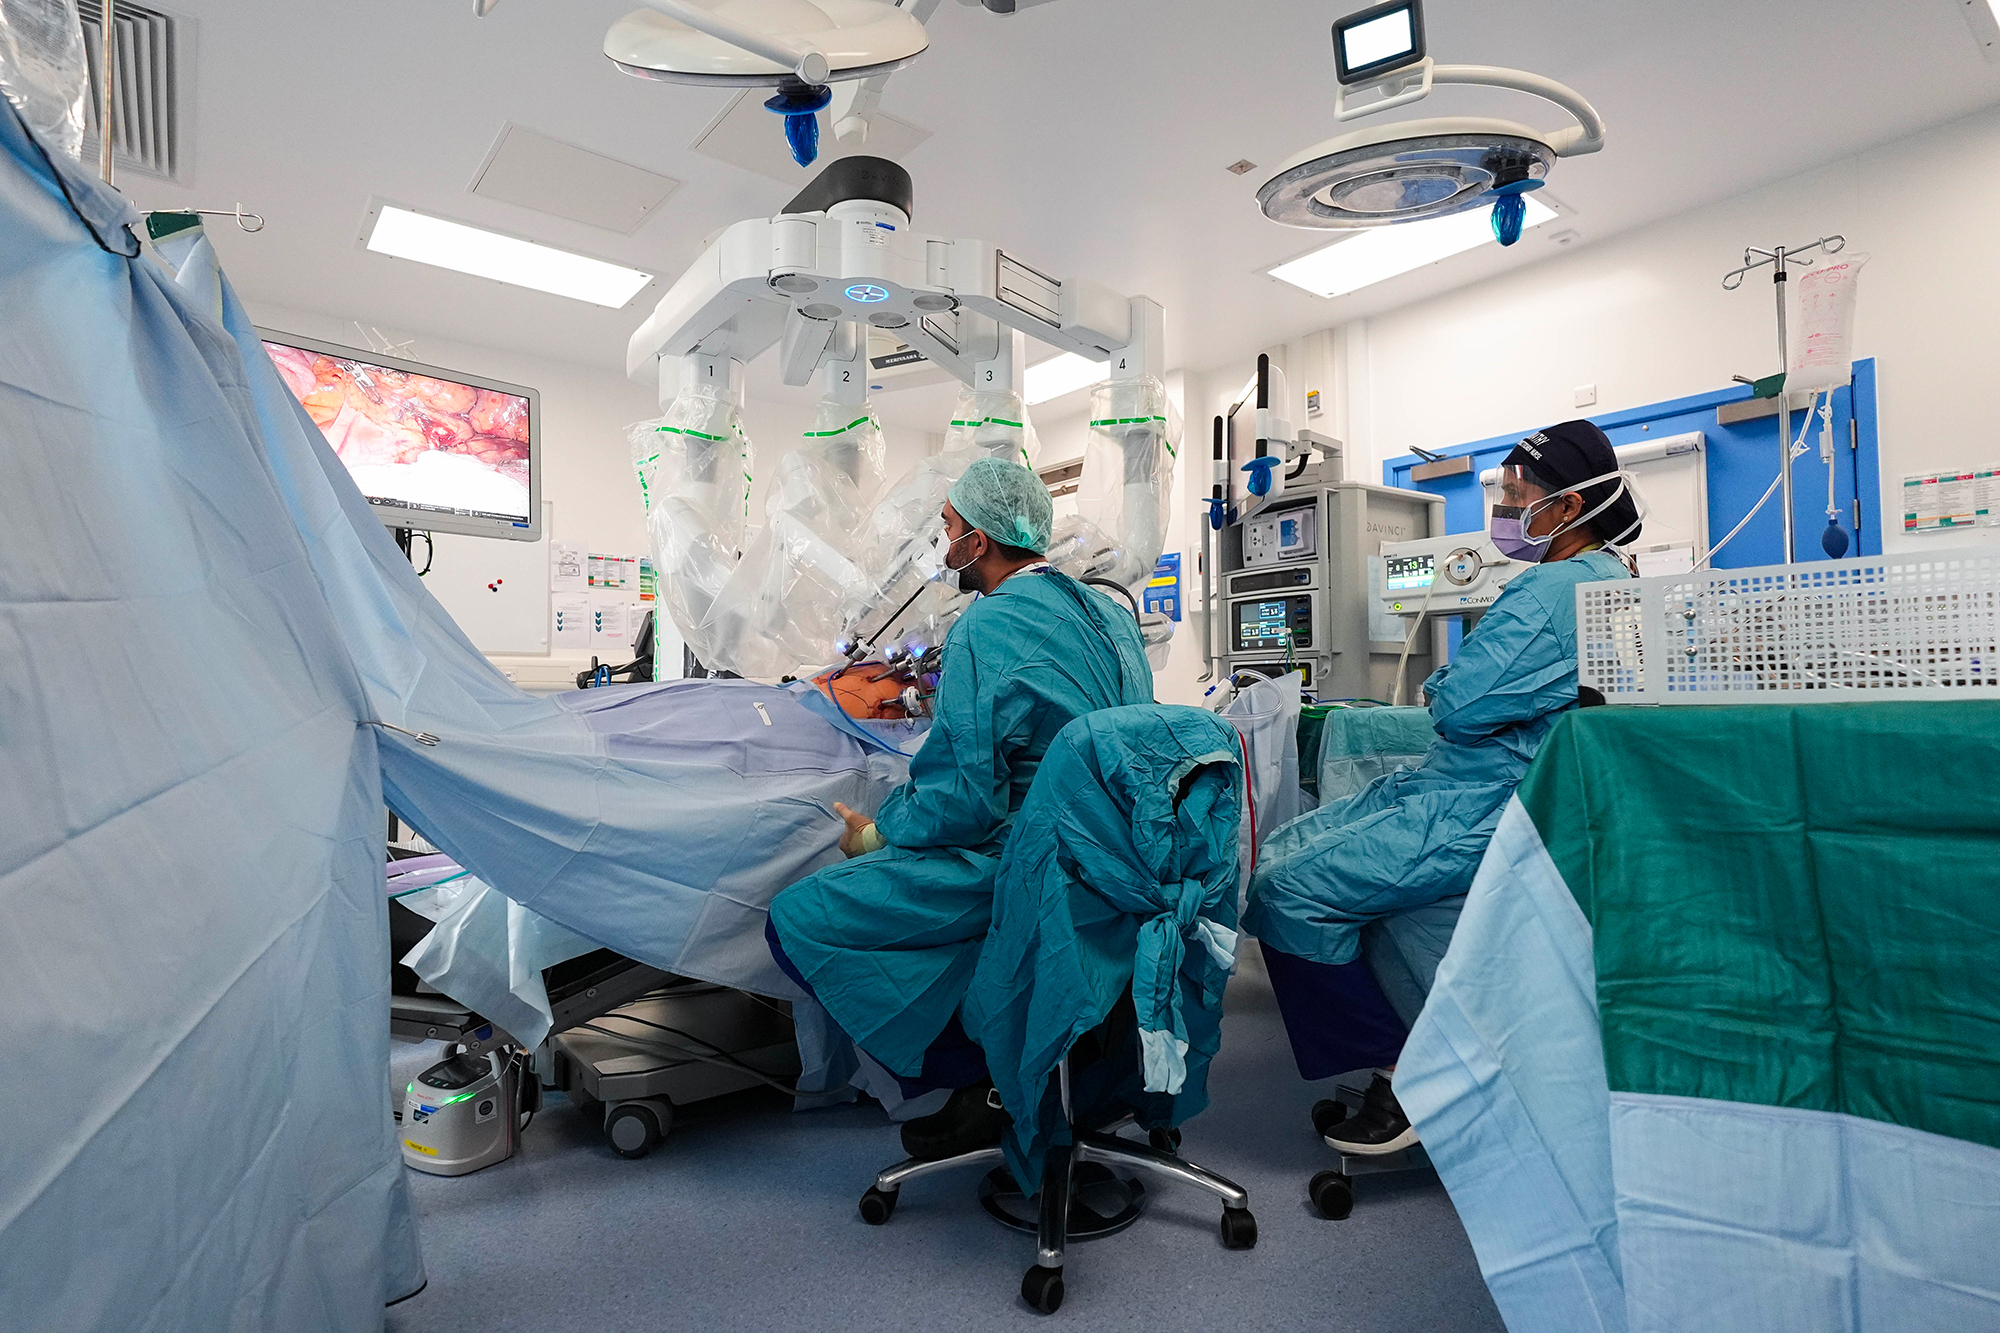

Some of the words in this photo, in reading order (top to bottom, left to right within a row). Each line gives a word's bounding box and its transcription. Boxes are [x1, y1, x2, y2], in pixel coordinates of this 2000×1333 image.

[1119, 358, 1126, 369] 4
[709, 365, 713, 377] 1
[843, 371, 850, 382] 2
[985, 370, 993, 382] 3
[1408, 560, 1418, 570] 13
